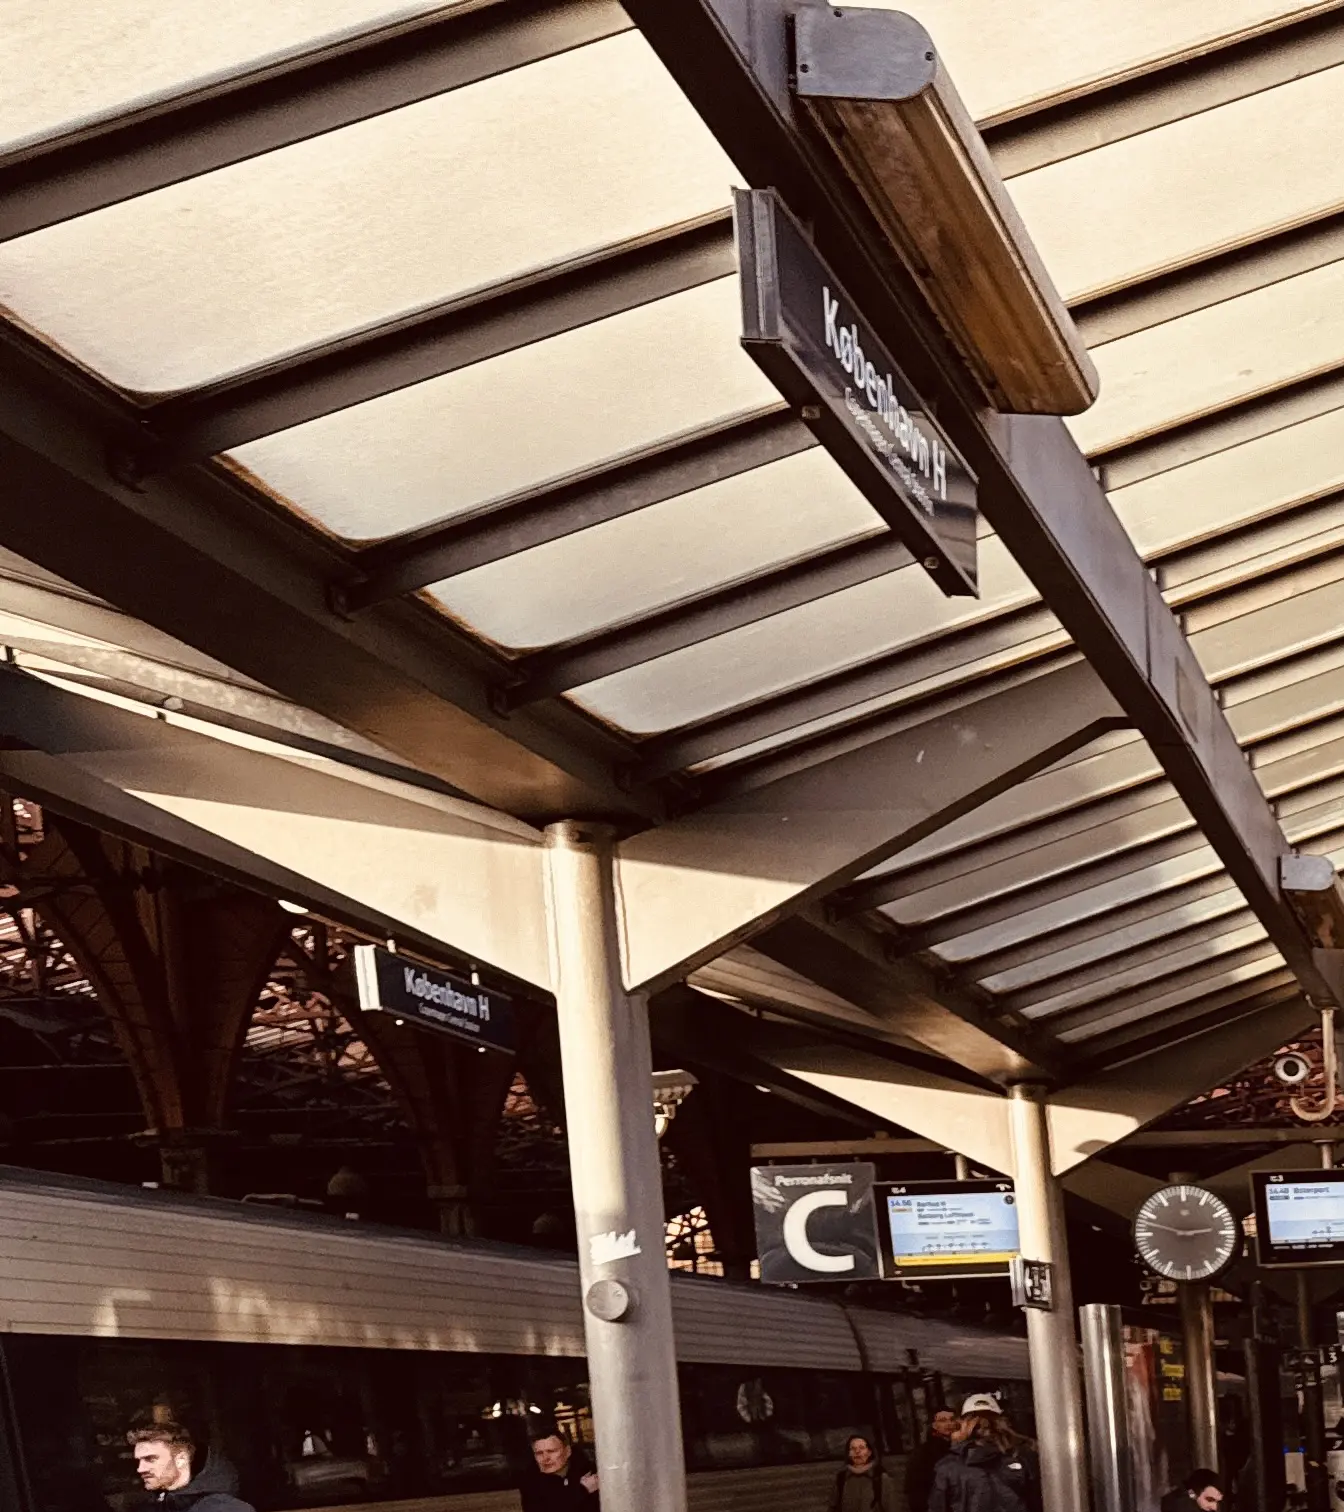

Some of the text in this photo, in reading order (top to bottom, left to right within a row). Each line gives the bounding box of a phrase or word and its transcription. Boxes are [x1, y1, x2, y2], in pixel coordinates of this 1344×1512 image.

[822, 286, 947, 500] København H
[404, 966, 490, 1021] København H
[774, 1173, 852, 1187] Perronafsnit
[783, 1189, 855, 1273] C
